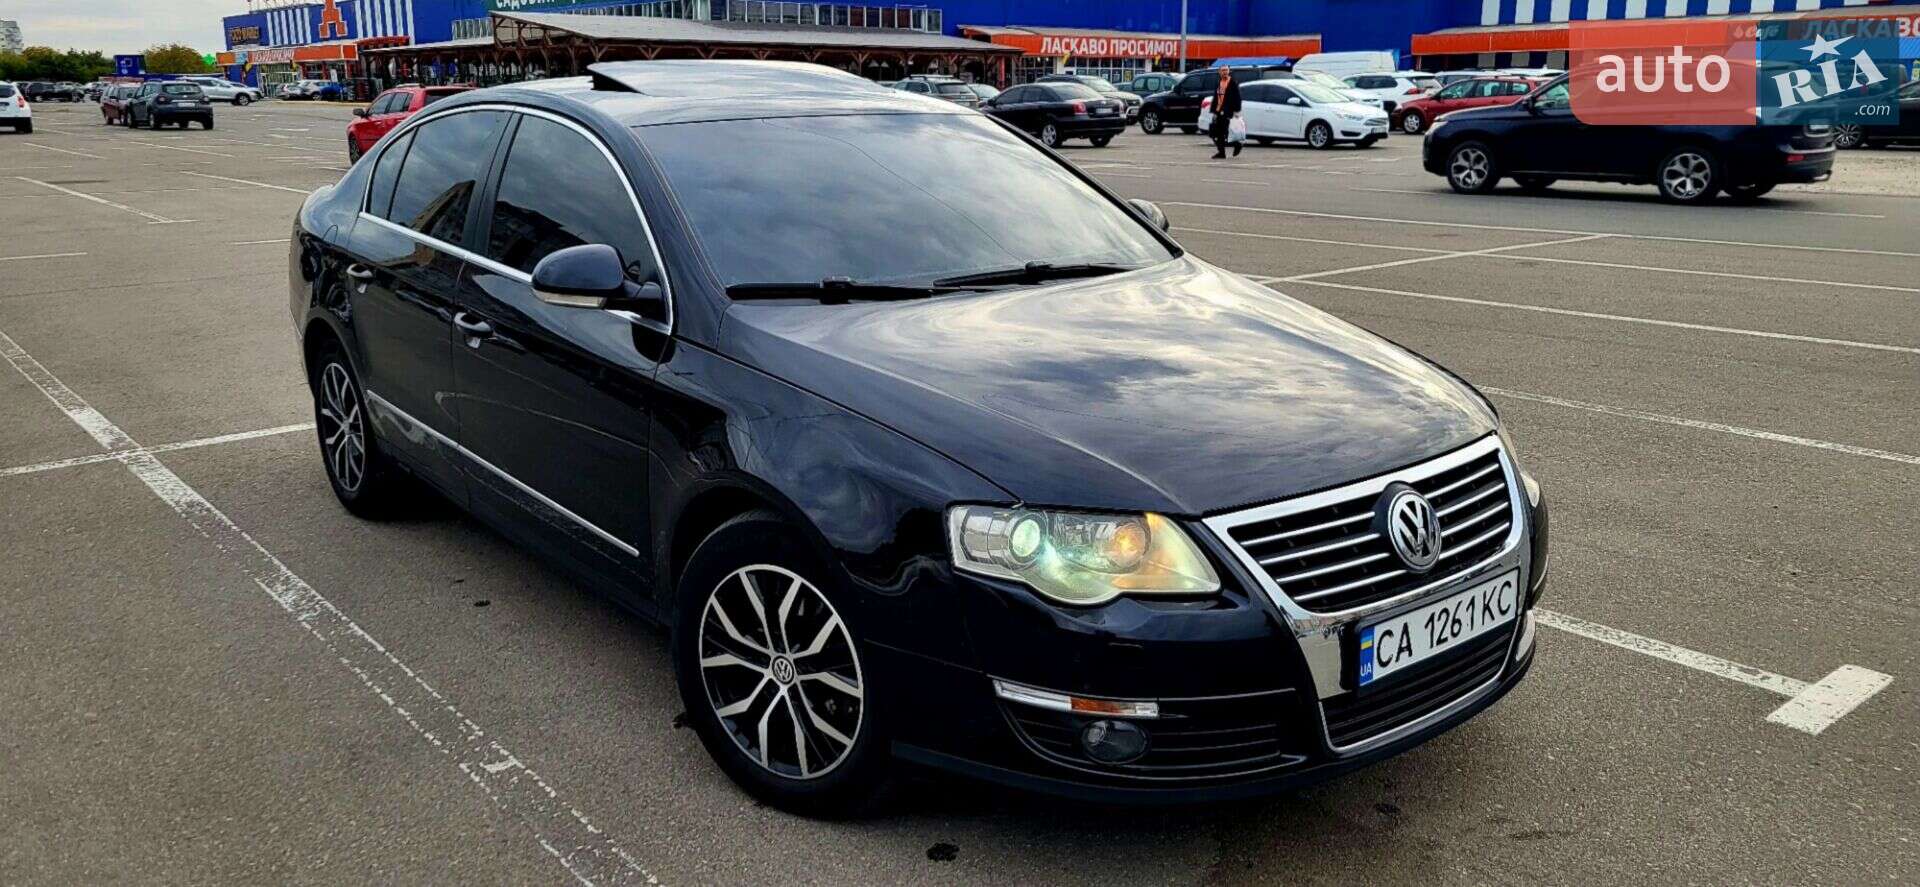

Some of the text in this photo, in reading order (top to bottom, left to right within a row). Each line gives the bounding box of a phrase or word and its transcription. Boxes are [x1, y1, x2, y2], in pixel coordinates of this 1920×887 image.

[1041, 37, 1178, 56] ЛАСКАВО ПРОСИМО!
[1376, 580, 1512, 668] CA 1261 KC
[1360, 663, 1373, 676] UA
